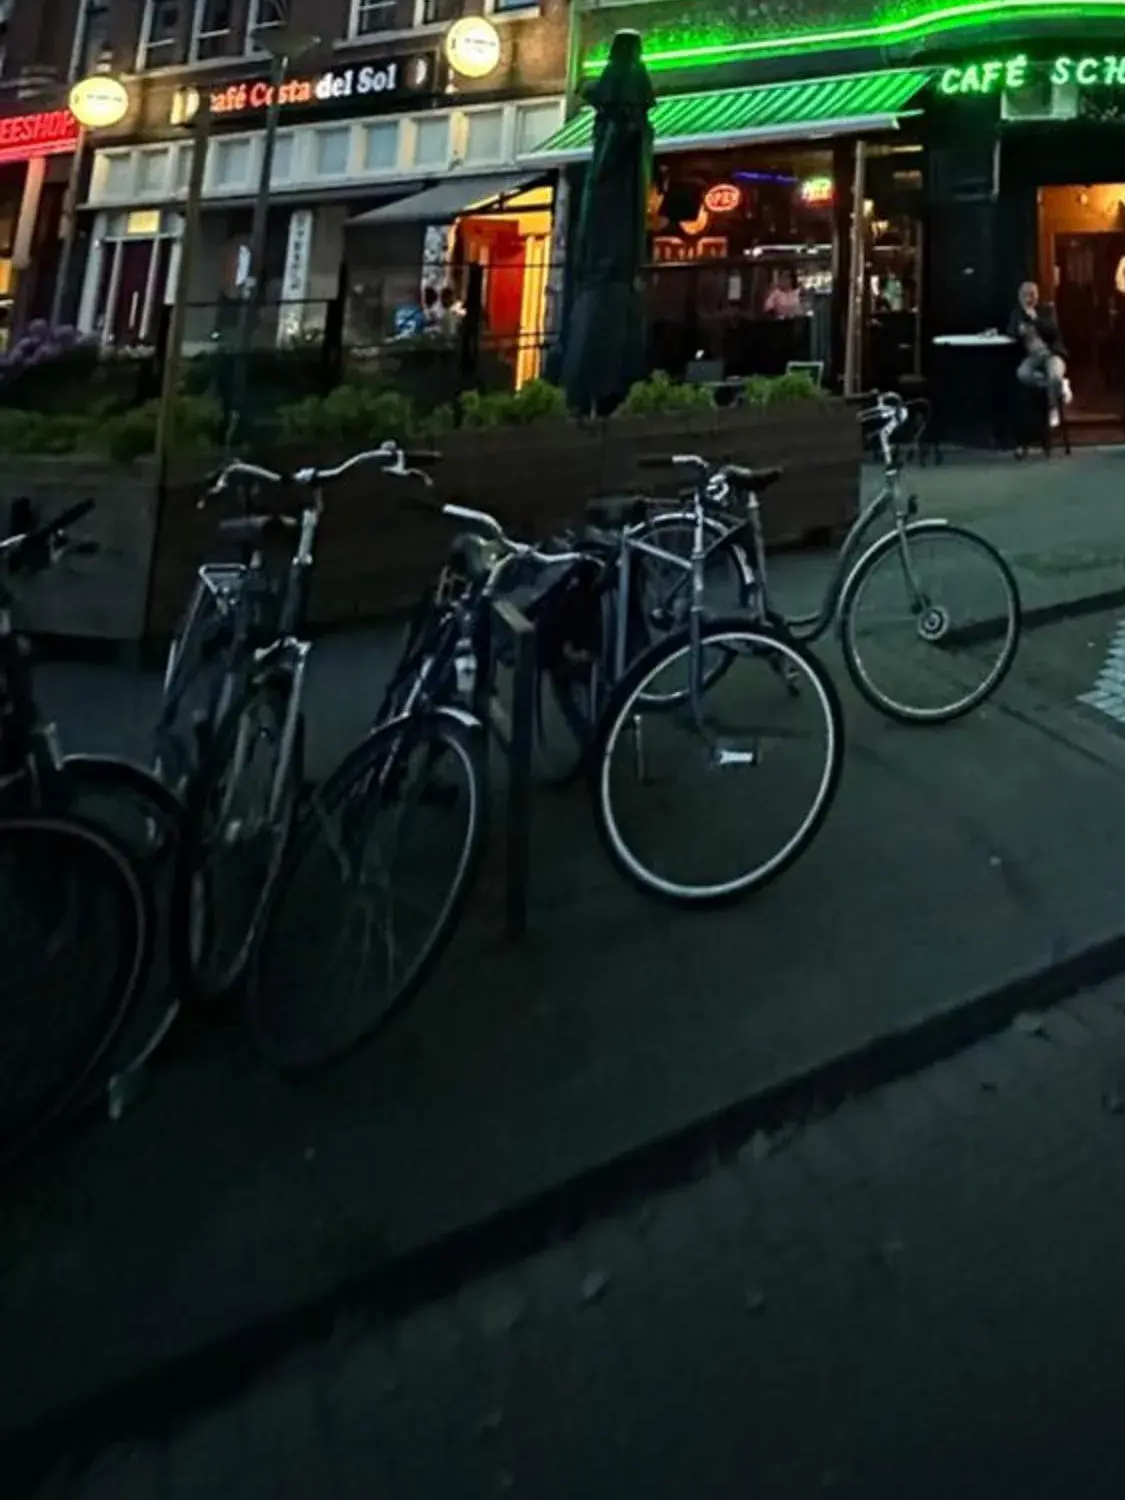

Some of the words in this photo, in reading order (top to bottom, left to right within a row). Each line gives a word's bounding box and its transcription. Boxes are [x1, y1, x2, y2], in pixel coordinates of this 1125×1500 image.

[315, 70, 352, 100] del
[356, 62, 398, 94] Sol
[940, 53, 1028, 94] CAFÉ
